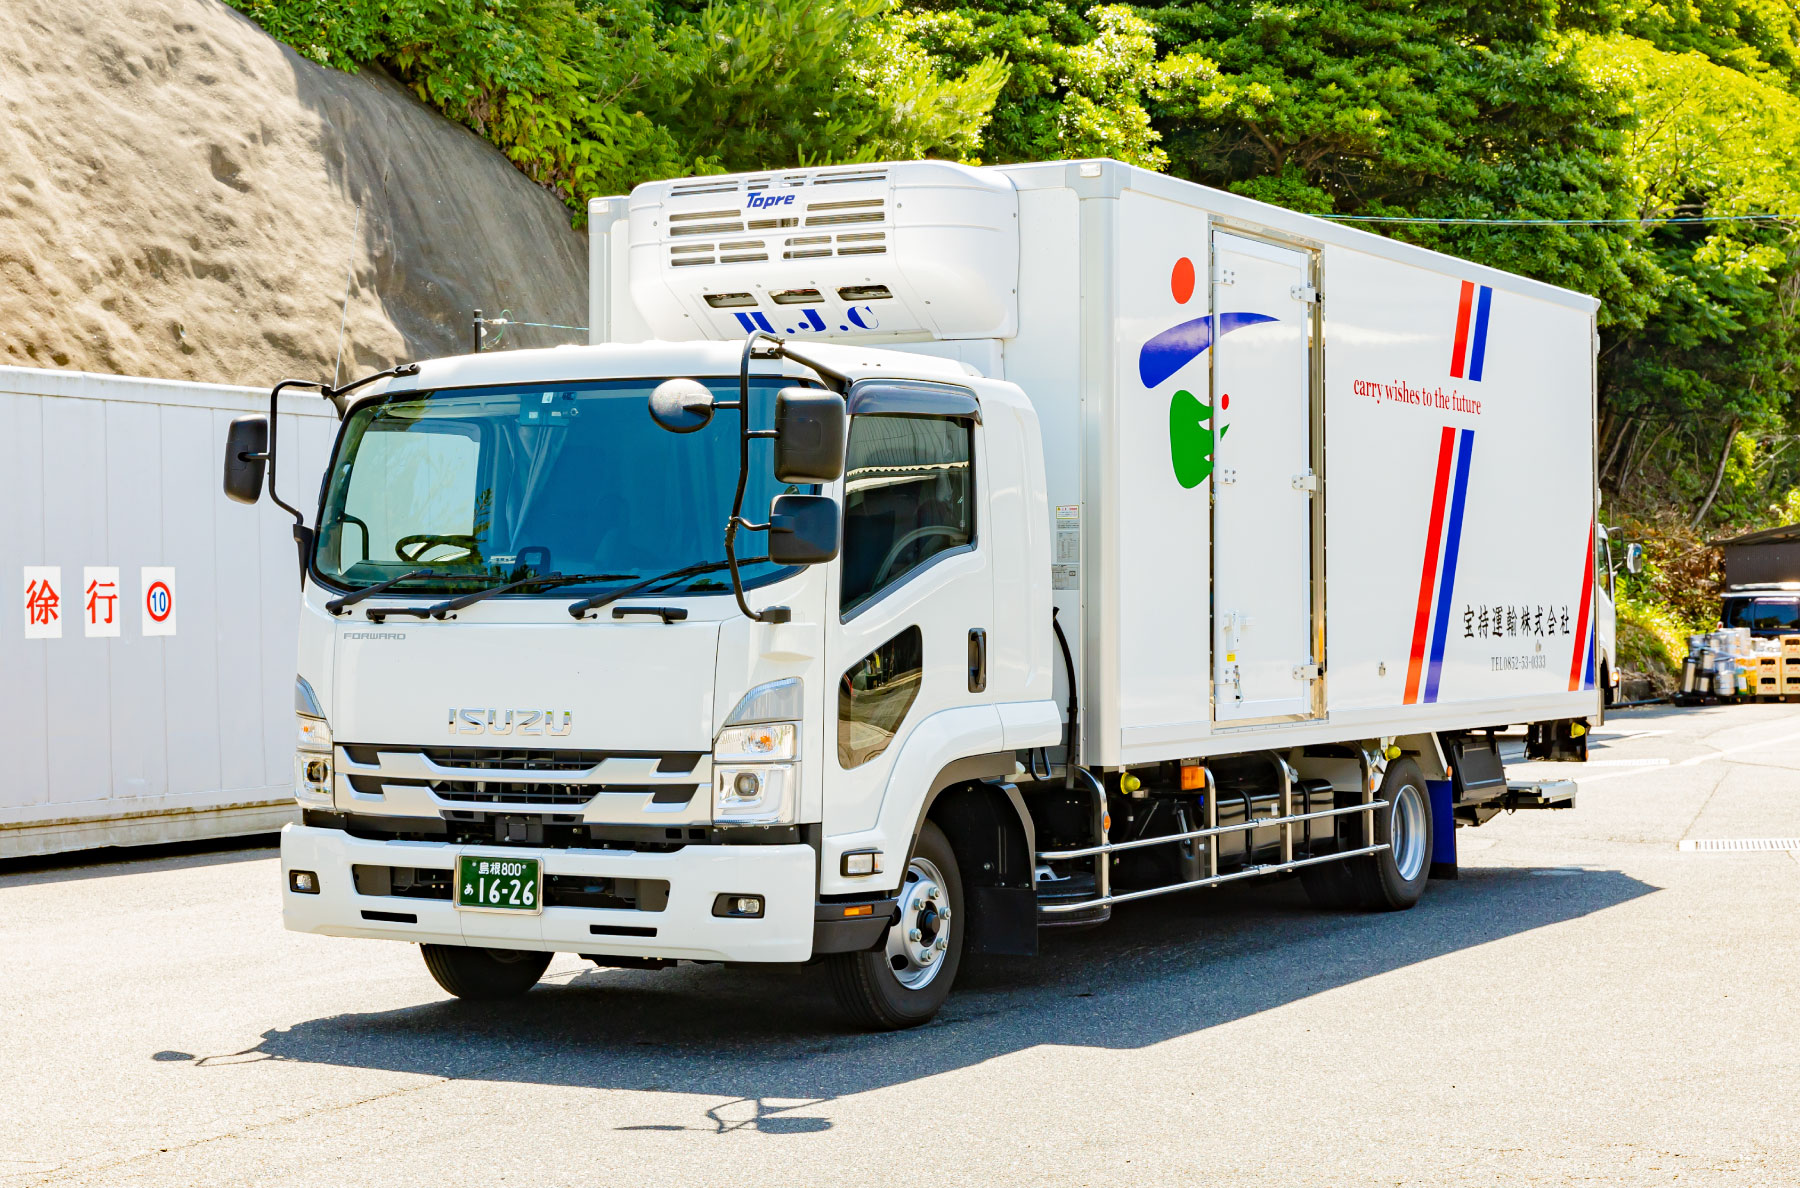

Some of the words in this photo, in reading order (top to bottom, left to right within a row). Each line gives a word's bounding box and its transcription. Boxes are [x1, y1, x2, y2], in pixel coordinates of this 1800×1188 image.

[747, 192, 796, 209] Topre
[1353, 378, 1383, 404] carry
[1385, 379, 1420, 405] wishes
[1422, 387, 1433, 407] to
[1434, 387, 1450, 410] the
[1452, 389, 1482, 415] future
[26, 578, 60, 625] 徐
[86, 579, 118, 624] 行
[151, 591, 167, 613] 10
[343, 632, 406, 640] FORWARD
[1463, 604, 1571, 639] 宝持運輸株式会社
[448, 707, 573, 737] ISUZU
[478, 861, 522, 877] 島根800
[464, 883, 474, 896] あ
[478, 877, 535, 906] 16-26
